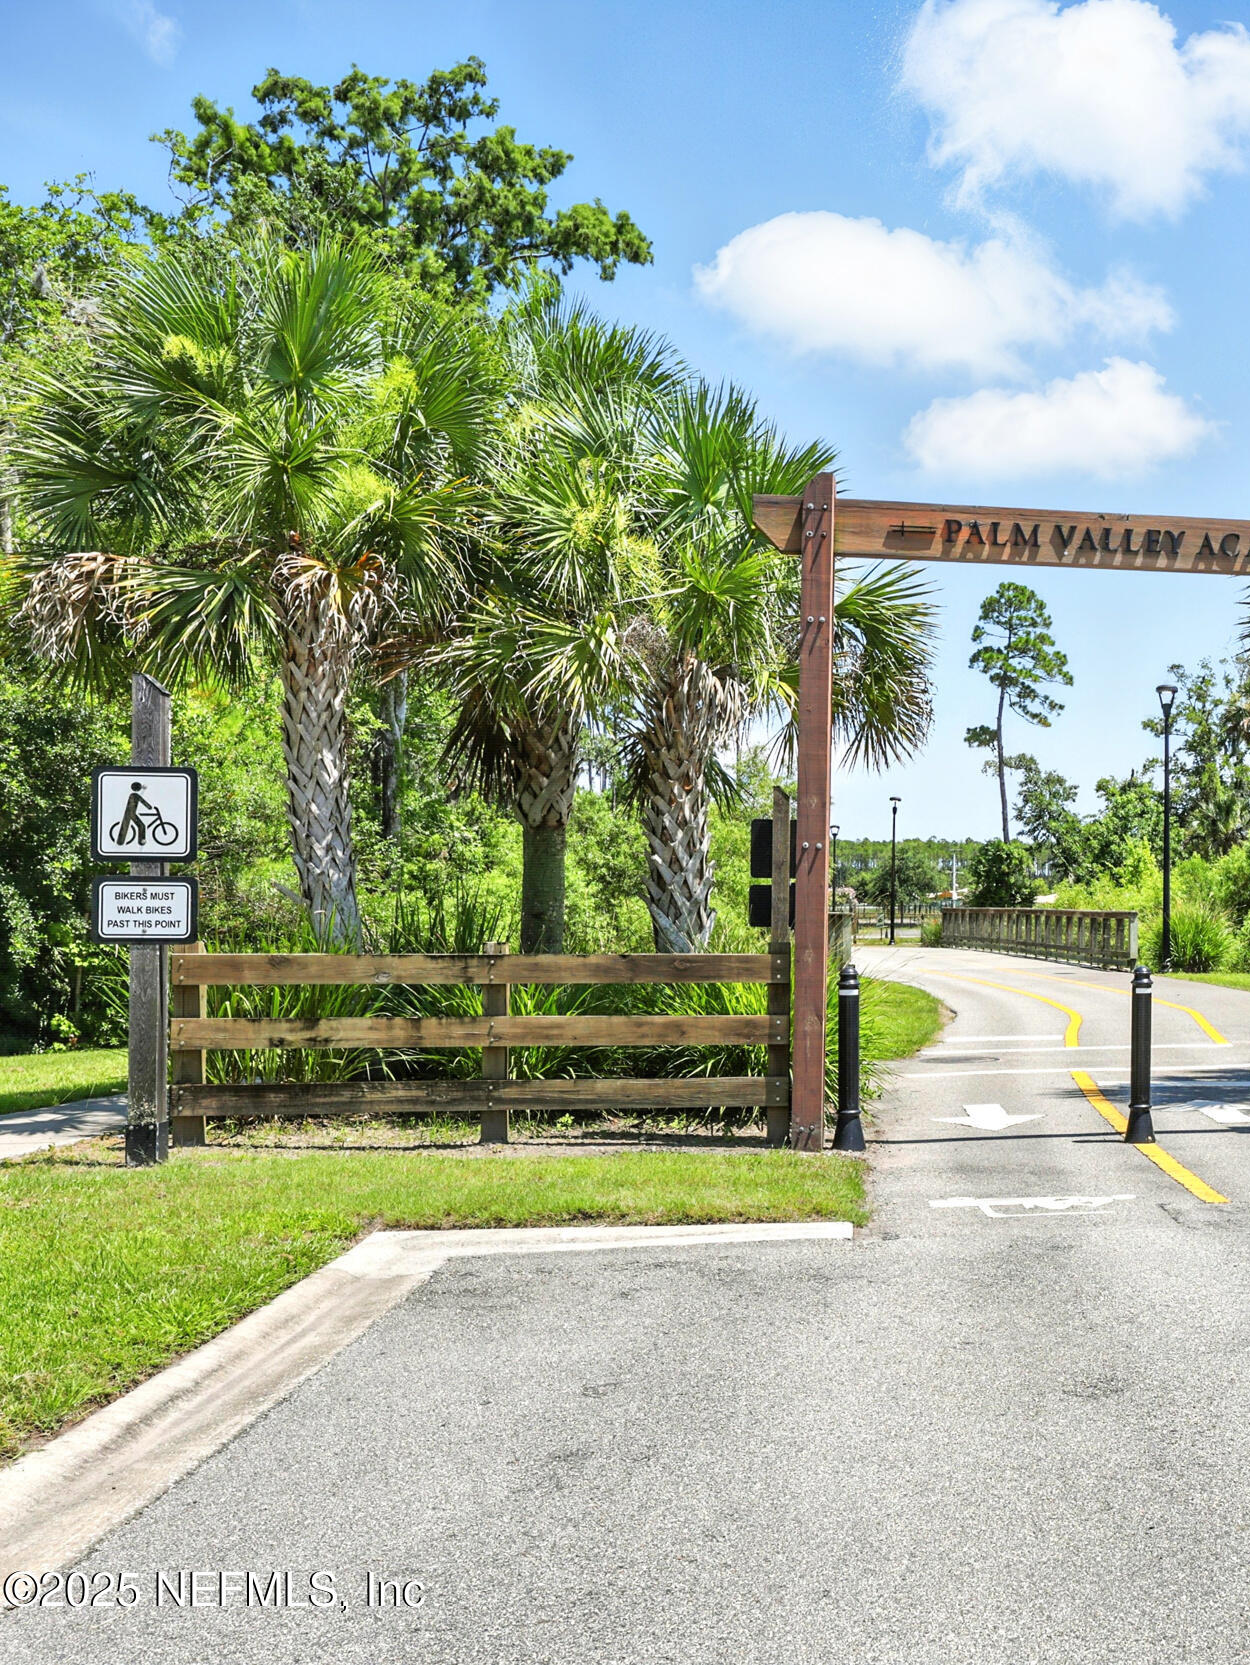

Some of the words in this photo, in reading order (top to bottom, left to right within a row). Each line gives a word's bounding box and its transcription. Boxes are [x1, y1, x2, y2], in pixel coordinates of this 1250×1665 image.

[944, 519, 1040, 547] PALM
[1054, 524, 1186, 555] VALLEY
[114, 892, 148, 900] BIKERS
[150, 892, 175, 901] MUST
[117, 906, 143, 914] WALK
[145, 906, 172, 914] BIKES
[107, 920, 130, 928] PAST
[132, 920, 153, 928] THIS
[154, 920, 182, 928] POINT
